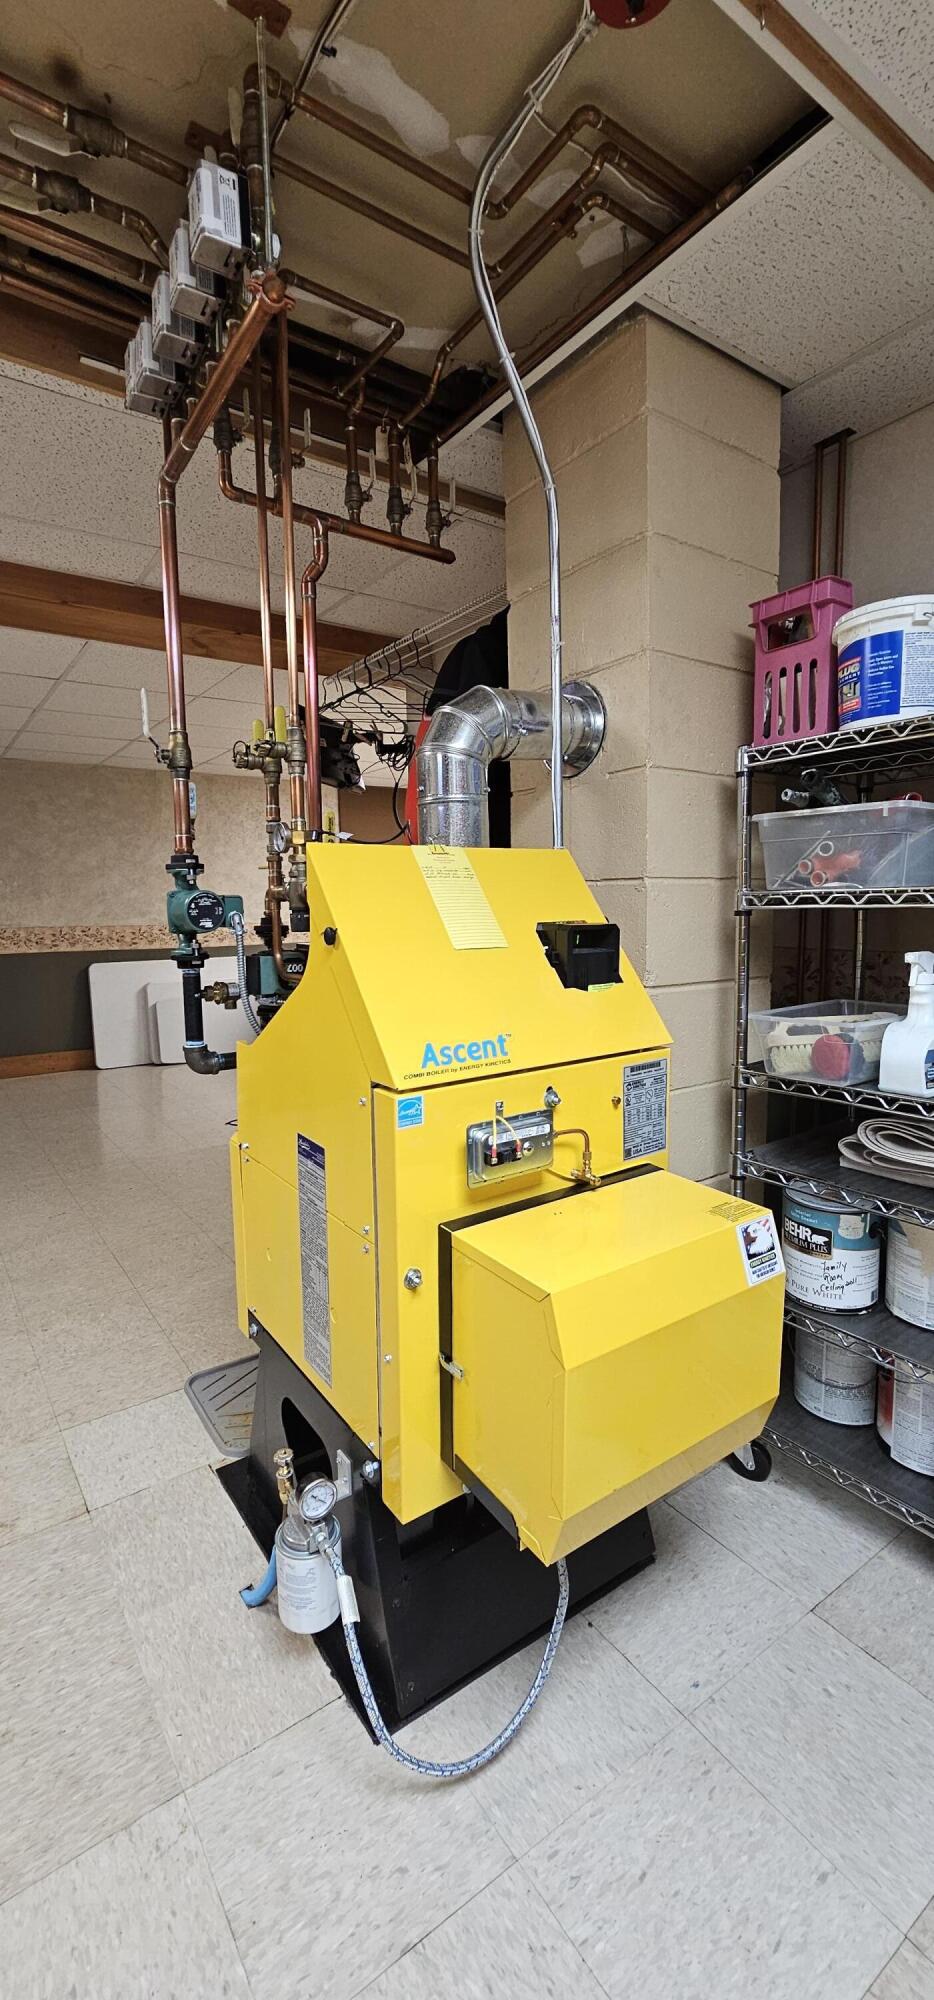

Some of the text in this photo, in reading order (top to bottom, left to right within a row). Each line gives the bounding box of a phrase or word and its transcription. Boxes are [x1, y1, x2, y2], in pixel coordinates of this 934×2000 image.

[839, 671, 861, 683] EMENT
[287, 964, 304, 973] 007
[421, 1034, 508, 1069] Ascent
[403, 1072, 425, 1080] COMBI
[426, 1067, 450, 1077] BOILER
[459, 1063, 484, 1071] ENERGY
[784, 1216, 812, 1243] BEHR
[809, 1242, 828, 1253] PLUS
[791, 1279, 809, 1293] PURE
[812, 1287, 842, 1300] WHITE
